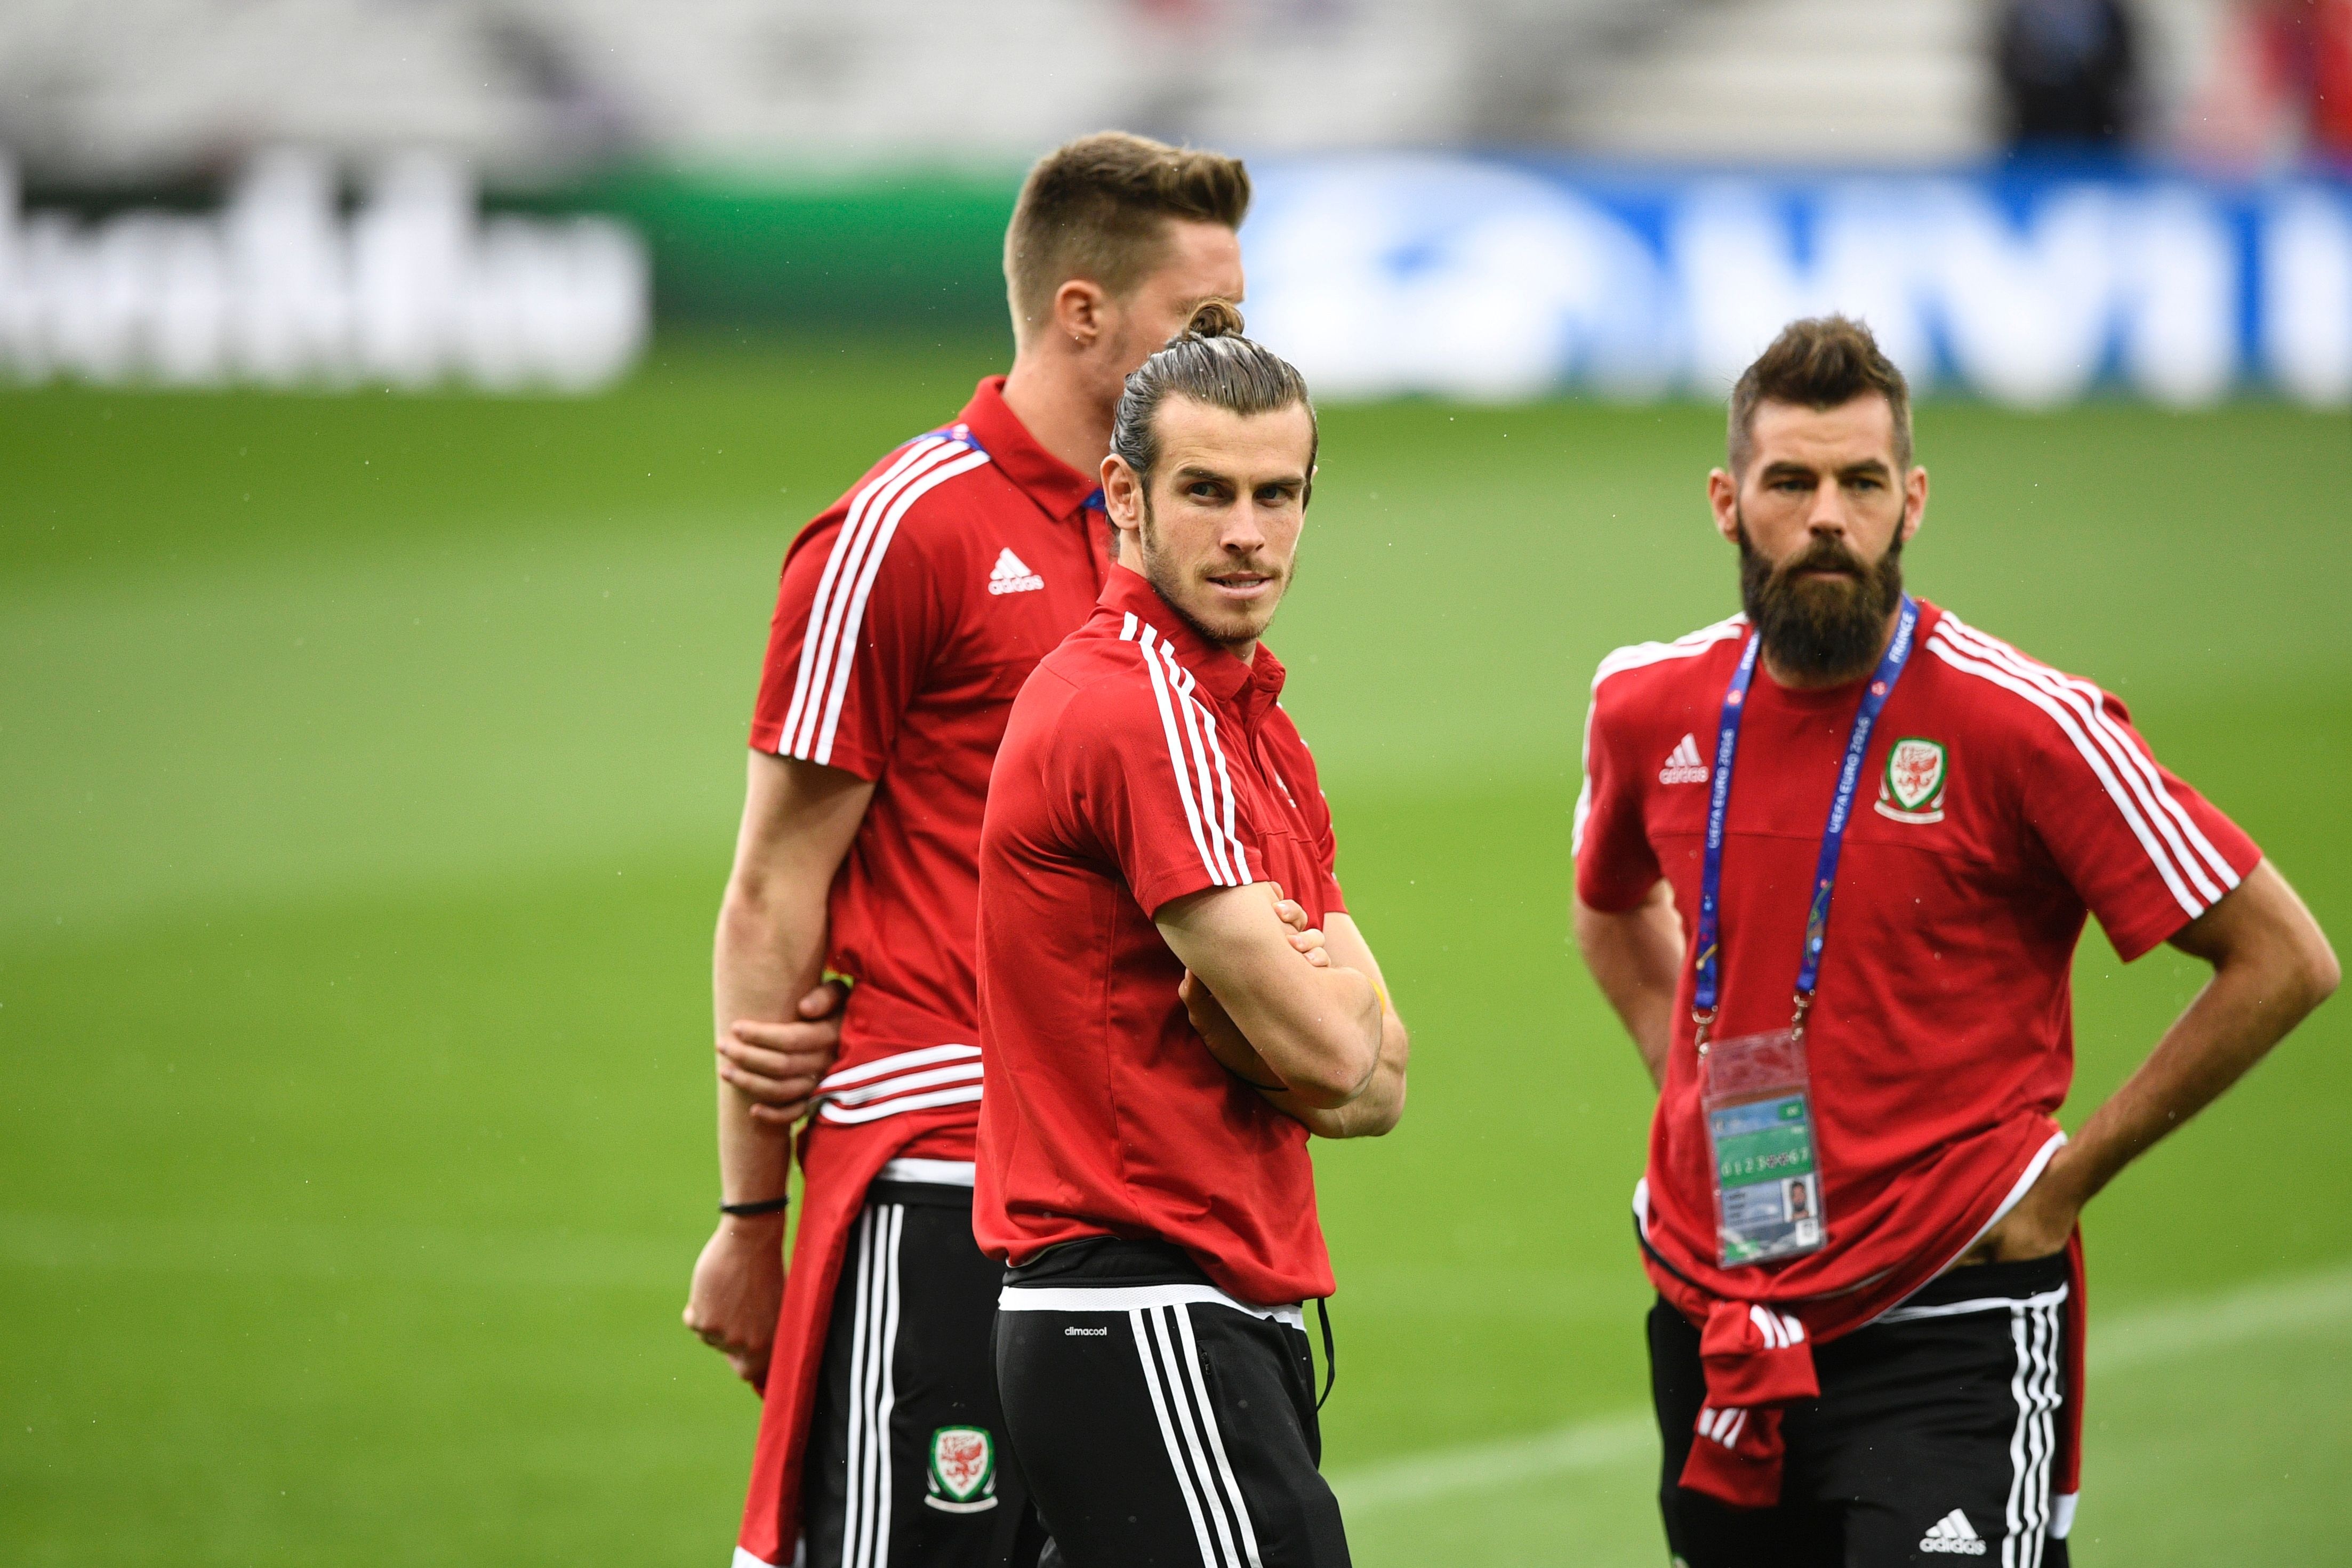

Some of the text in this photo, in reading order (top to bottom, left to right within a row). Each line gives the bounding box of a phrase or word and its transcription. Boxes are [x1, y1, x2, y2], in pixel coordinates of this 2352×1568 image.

[988, 575, 1045, 595] adidas
[1889, 610, 1915, 663] FRANCE
[1659, 766, 1709, 784] adidas
[1828, 717, 1871, 833] UEFA EURO 2016
[1708, 728, 1735, 848] UEFA EURO 2016
[1064, 1326, 1107, 1336] climacool
[1920, 1538, 1987, 1556] adidas
